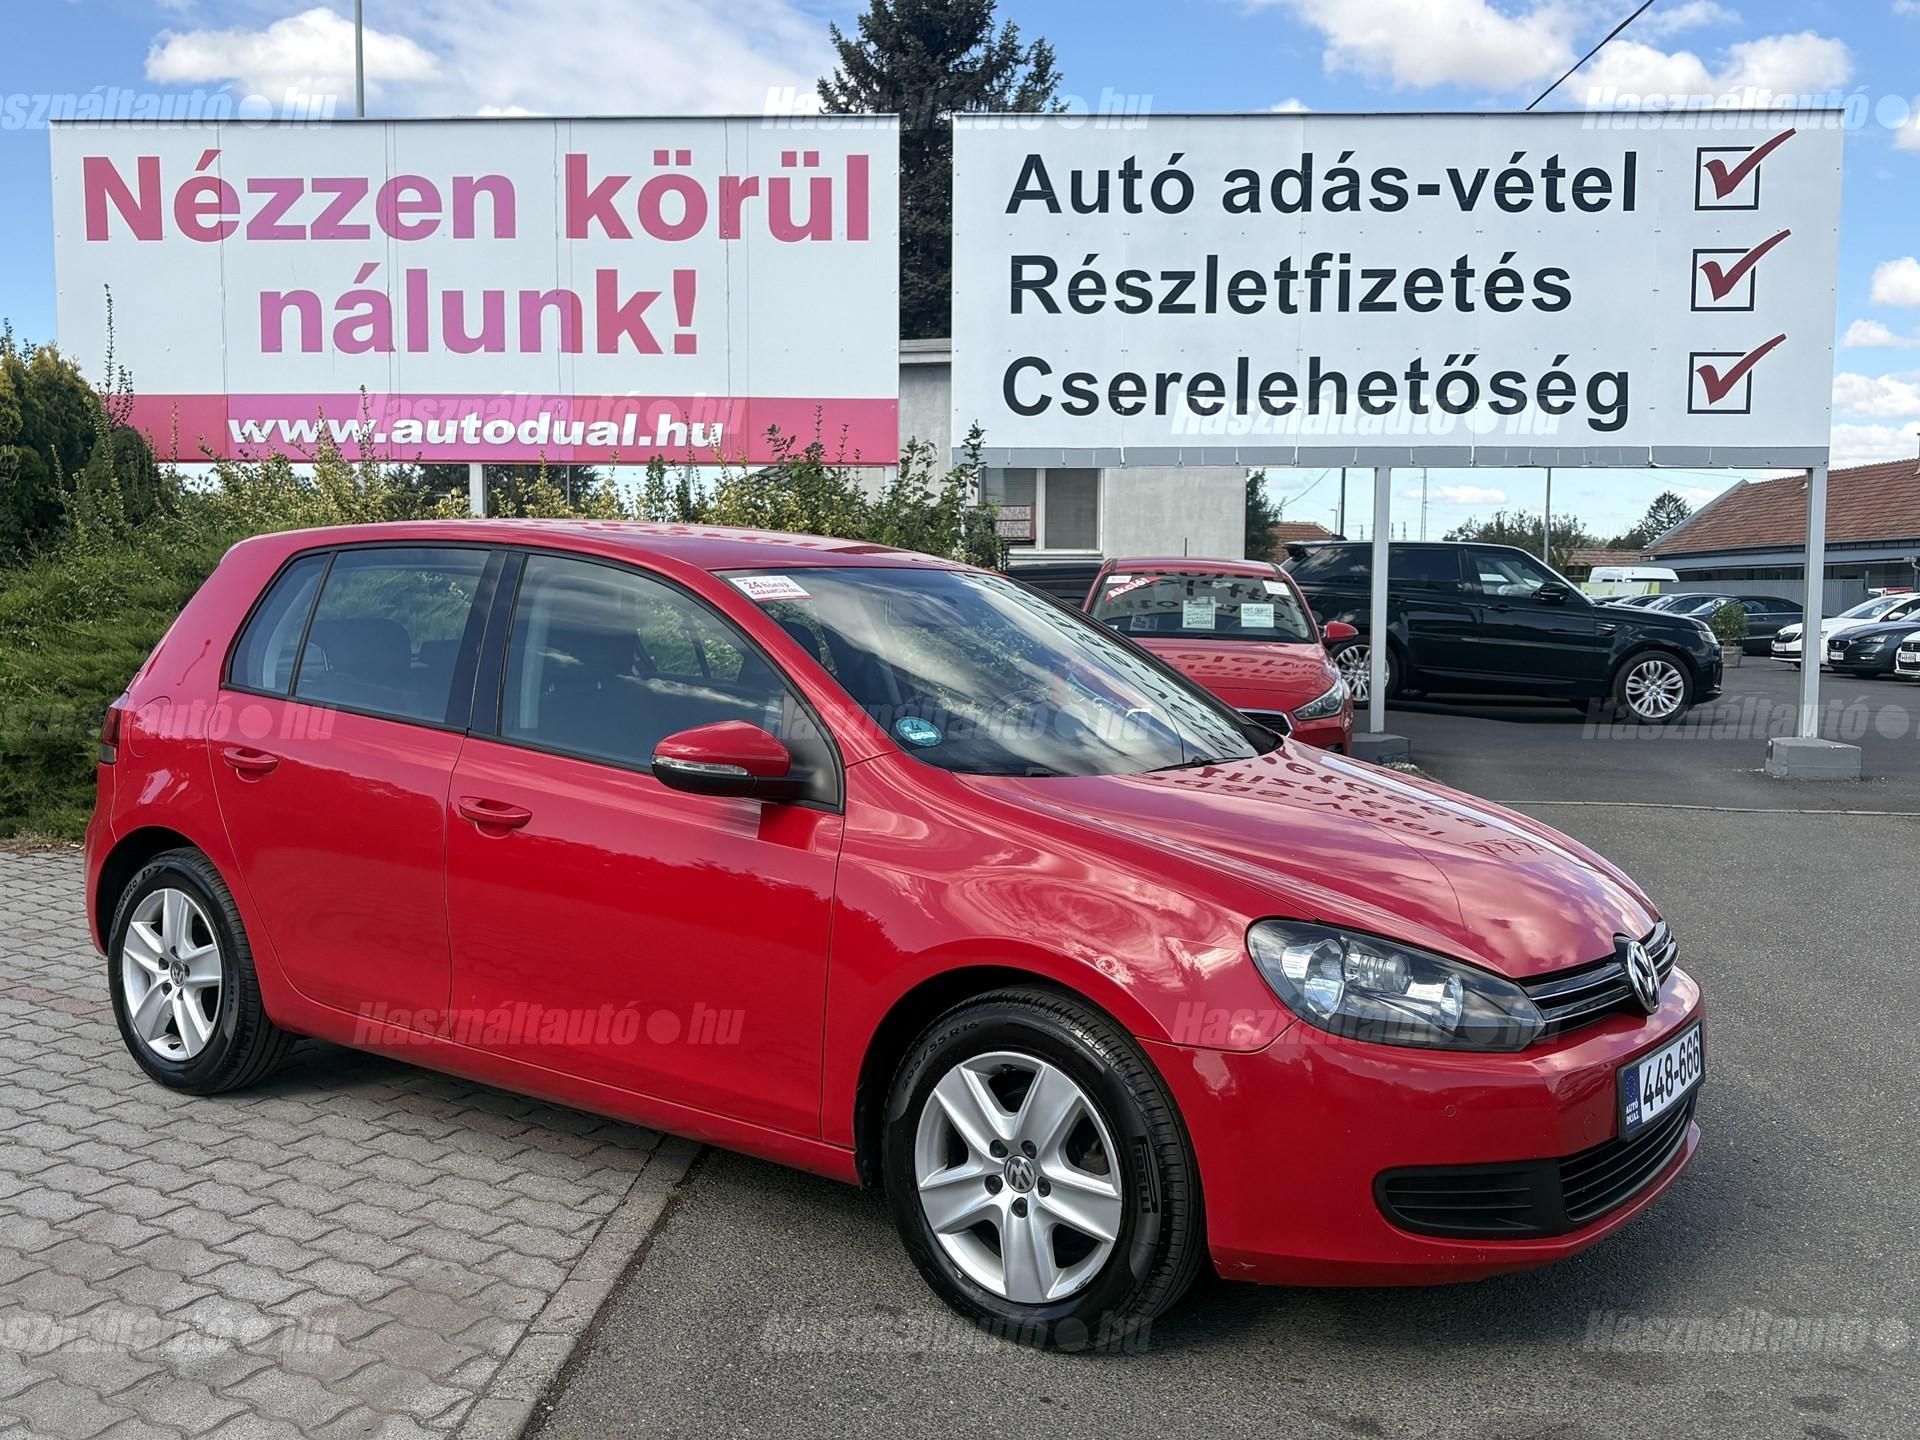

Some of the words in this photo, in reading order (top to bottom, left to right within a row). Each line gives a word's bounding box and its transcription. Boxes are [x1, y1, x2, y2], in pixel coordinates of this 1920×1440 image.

[84, 150, 516, 242] Nézzen
[566, 149, 870, 242] körül
[1005, 152, 1195, 214] Autó
[1223, 150, 1637, 214] adás-vétel
[261, 262, 698, 355] nálunk!
[1010, 251, 1572, 315] Részletfizetés
[228, 411, 723, 447] www.autodual.hu
[1002, 353, 1630, 432] Cserelehetőség
[1643, 1030, 1700, 1112] 448-666
